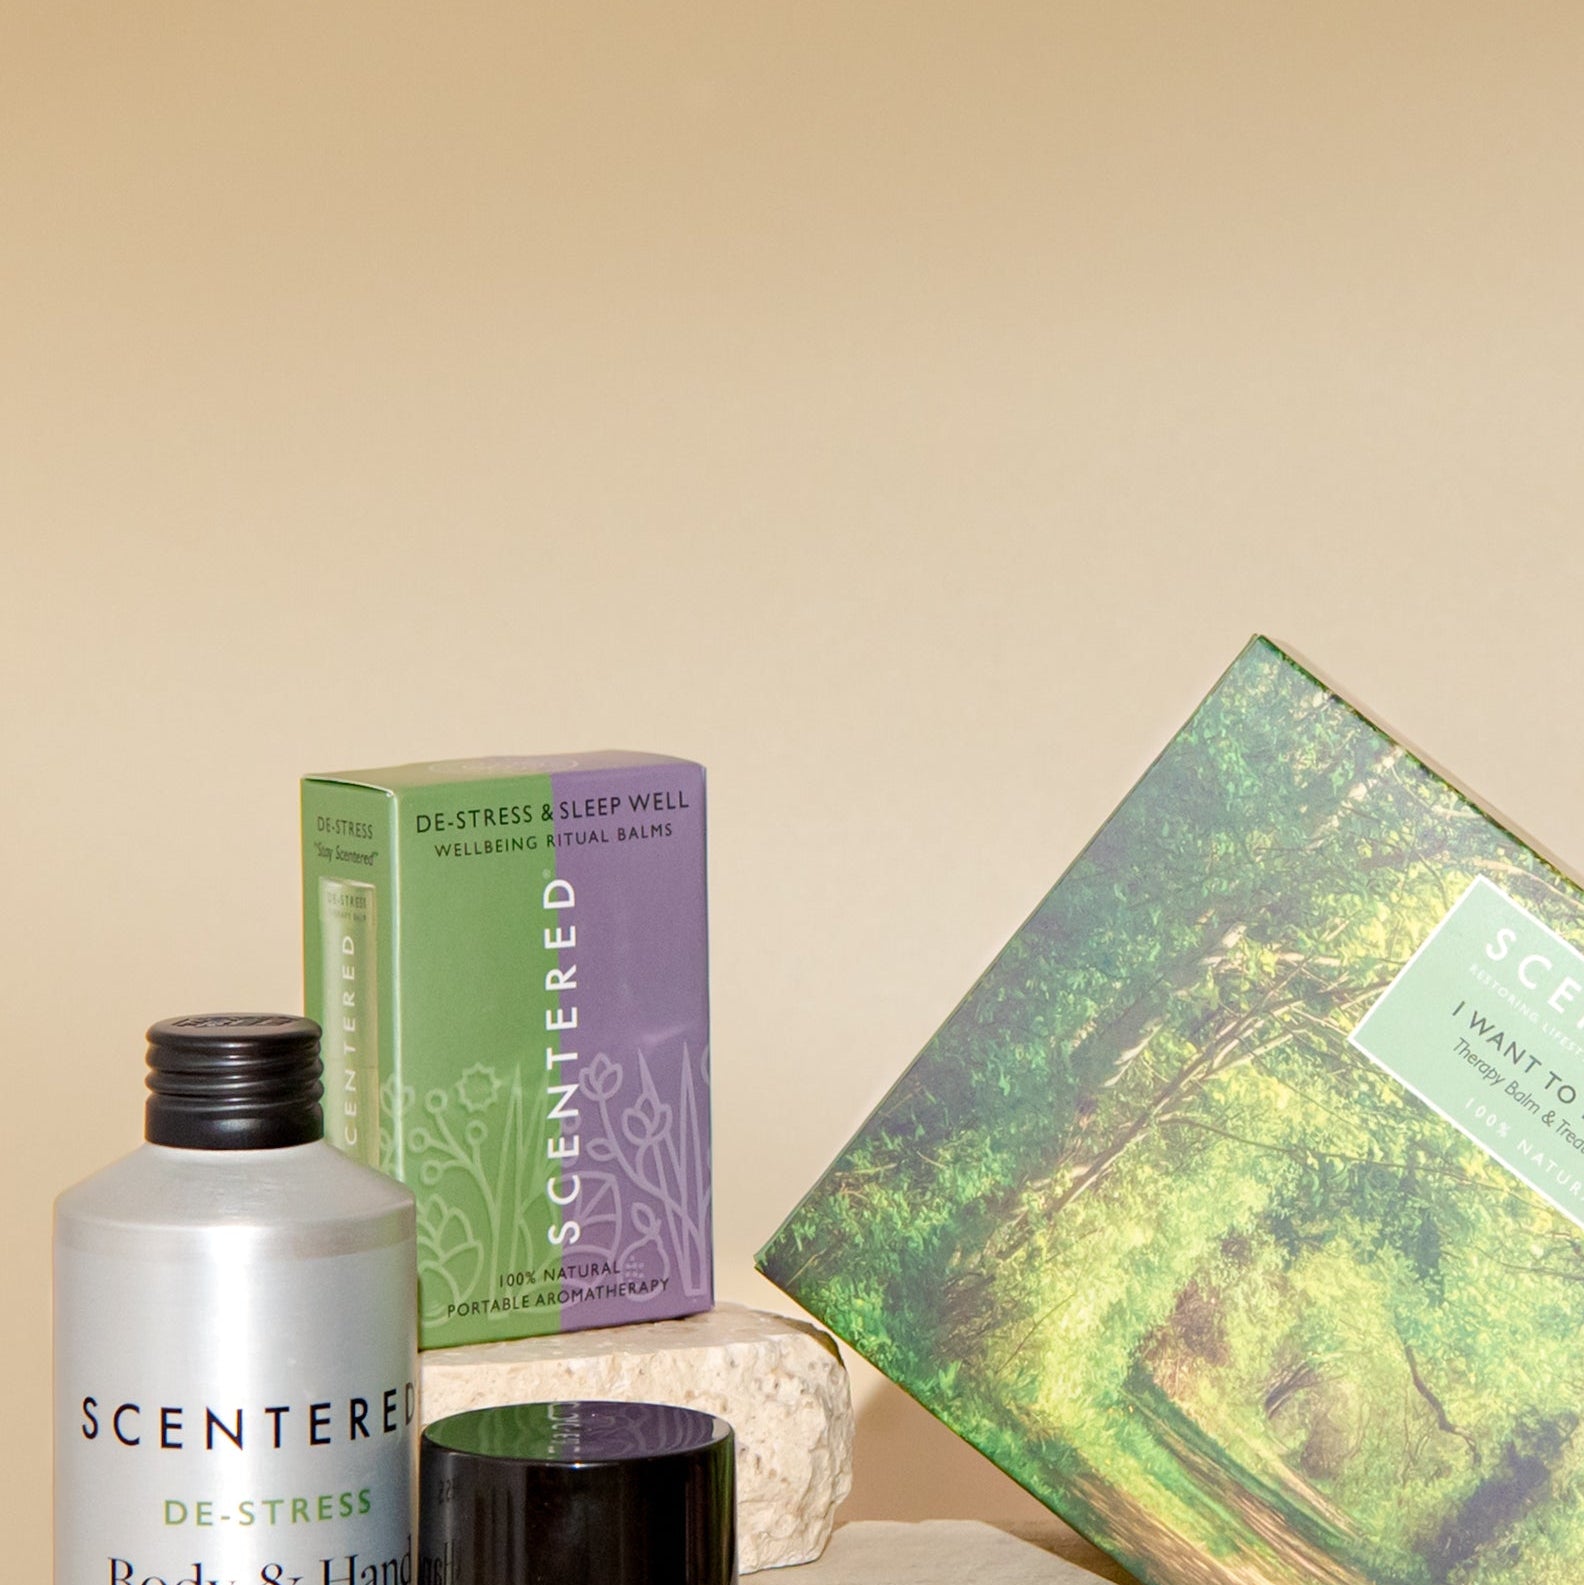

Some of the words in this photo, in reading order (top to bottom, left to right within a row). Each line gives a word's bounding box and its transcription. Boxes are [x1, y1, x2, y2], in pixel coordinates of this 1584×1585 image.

[316, 816, 374, 840] DE-STRESS
[413, 803, 535, 834] DE-STRESS
[540, 803, 555, 822] &
[560, 797, 622, 820] SLEEP
[628, 790, 690, 813] WELL
[434, 835, 539, 858] WELLBEING
[546, 830, 610, 849] RITUAL
[617, 822, 674, 842] BALMS
[1468, 963, 1539, 1024] RESTORING
[543, 877, 582, 1246] SCENTERED
[1452, 1000, 1466, 1018] I
[1469, 1010, 1543, 1074] WANT
[1543, 1071, 1577, 1105] TO
[1452, 1036, 1506, 1087] Therapy
[1505, 1080, 1541, 1115] Balm
[1541, 1109, 1557, 1127] &
[1464, 1096, 1511, 1139] 100%
[499, 1271, 537, 1289] 100%
[543, 1260, 622, 1282] NATURAL
[446, 1295, 530, 1319] PORTABLE
[535, 1277, 671, 1307] AROMATHERAPY
[81, 1381, 415, 1451] SCENTERED
[164, 1488, 372, 1526] DE-STRESS
